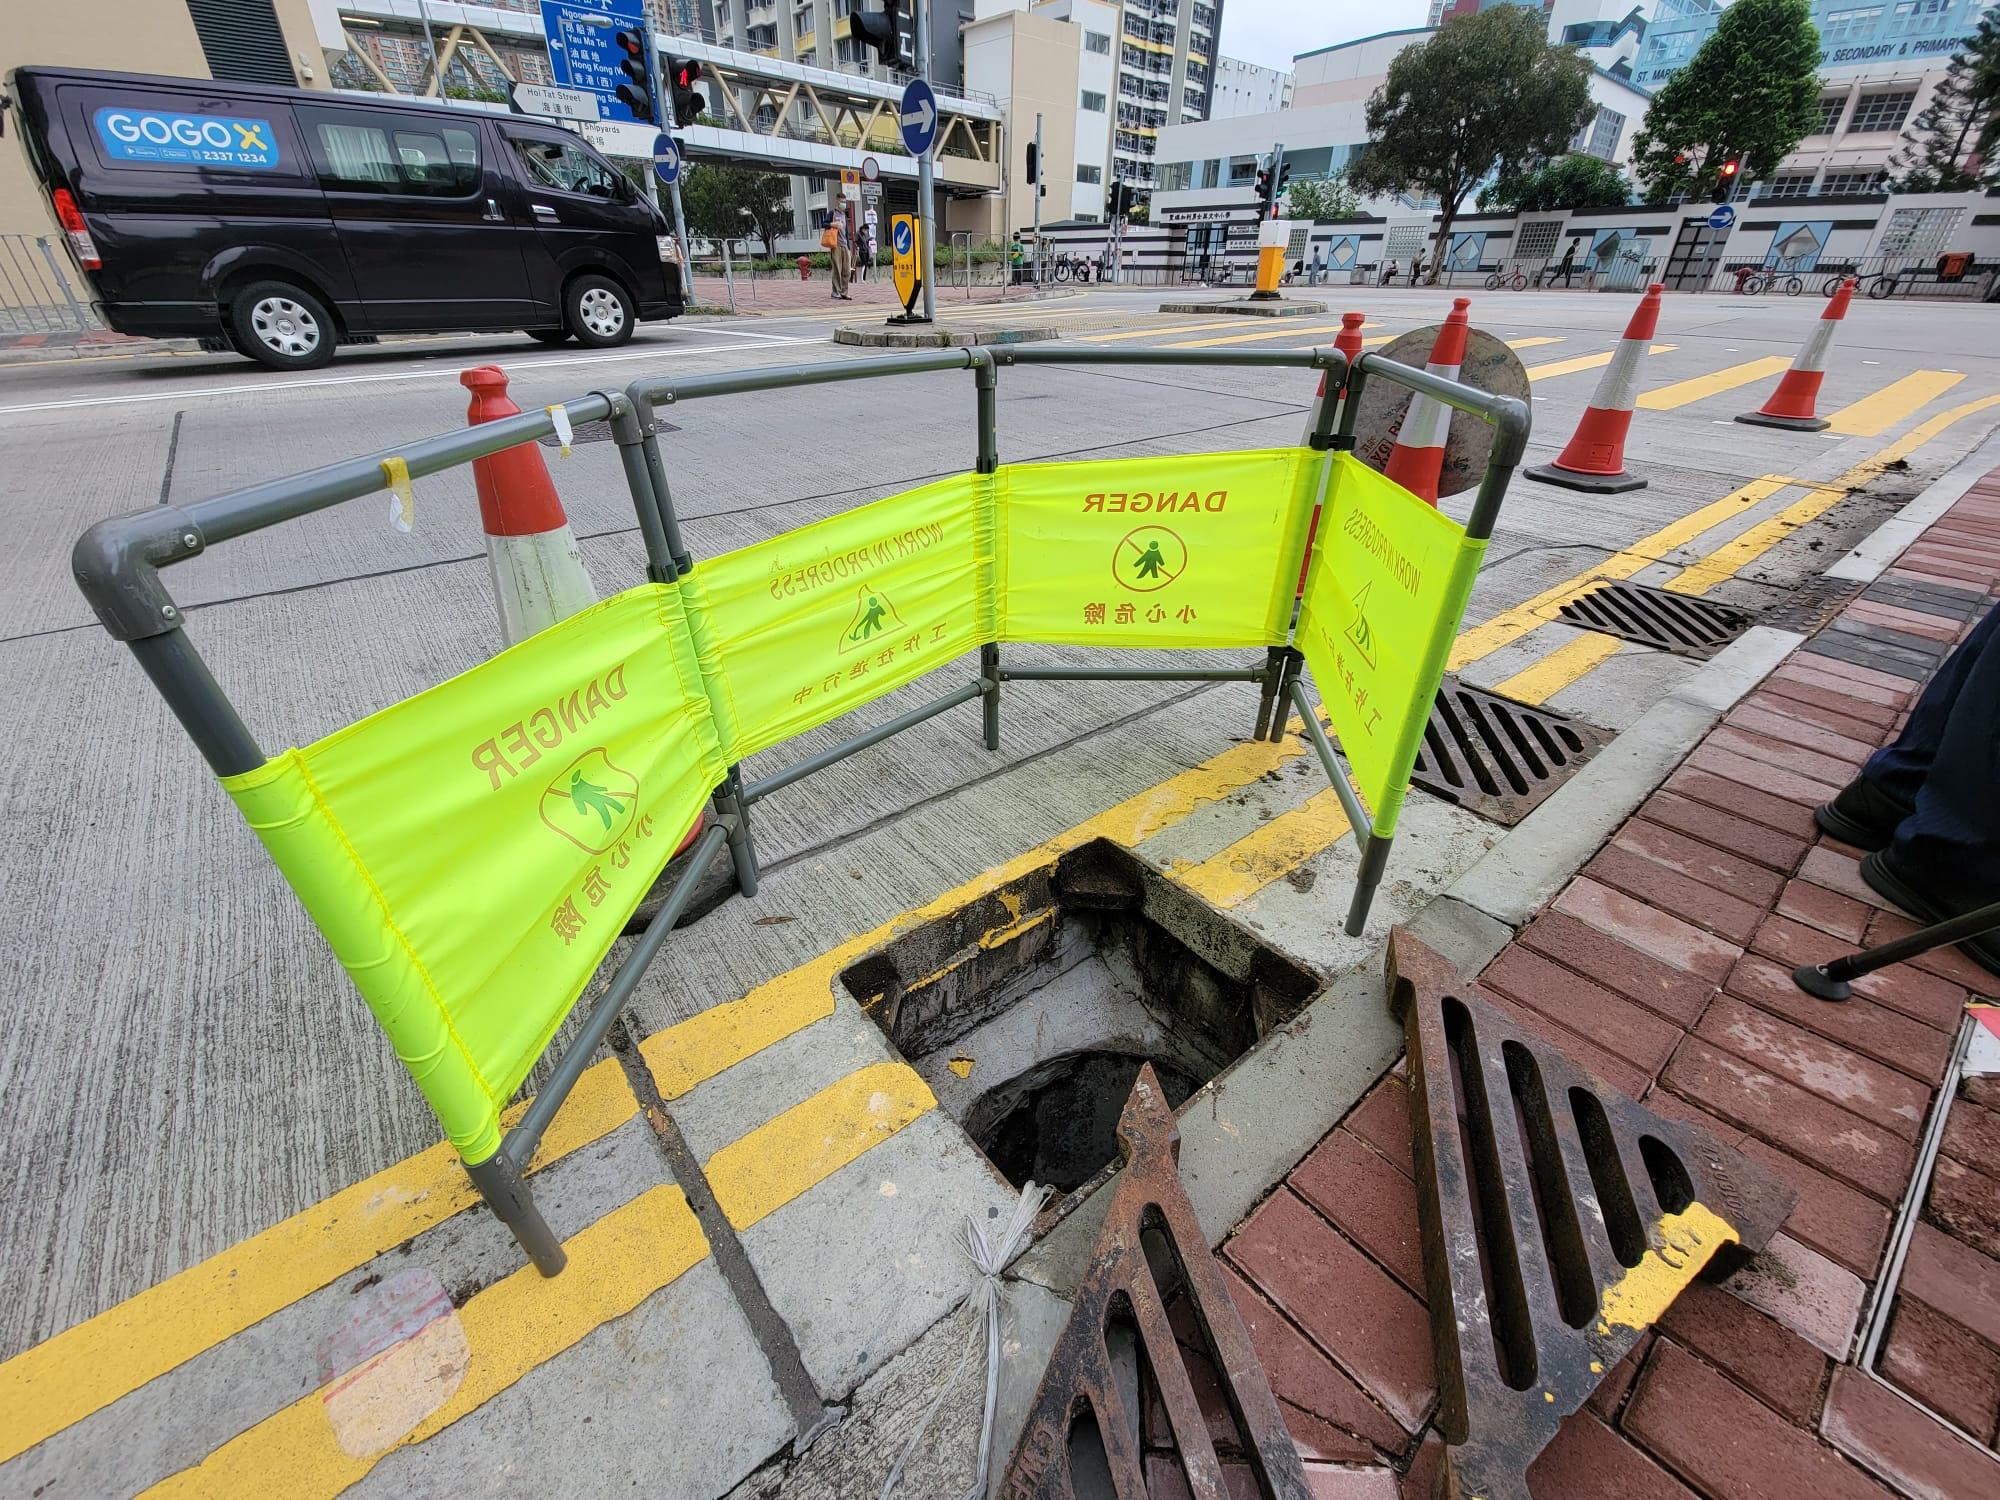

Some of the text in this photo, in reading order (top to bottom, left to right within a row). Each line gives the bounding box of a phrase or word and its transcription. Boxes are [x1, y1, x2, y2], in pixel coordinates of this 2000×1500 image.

[615, 18, 634, 28] Chau
[567, 34, 608, 48] Yau Ma Tei
[1833, 43, 1896, 62] SECONDARY
[1900, 42, 1908, 55] &
[1913, 37, 1961, 54] PRIMARY
[572, 60, 592, 72] Hong
[593, 63, 613, 75] Kong
[527, 88, 582, 102] Hoi Tat Street
[584, 123, 620, 134] Shipyards
[203, 151, 233, 162] 2337
[237, 153, 268, 164] 1234
